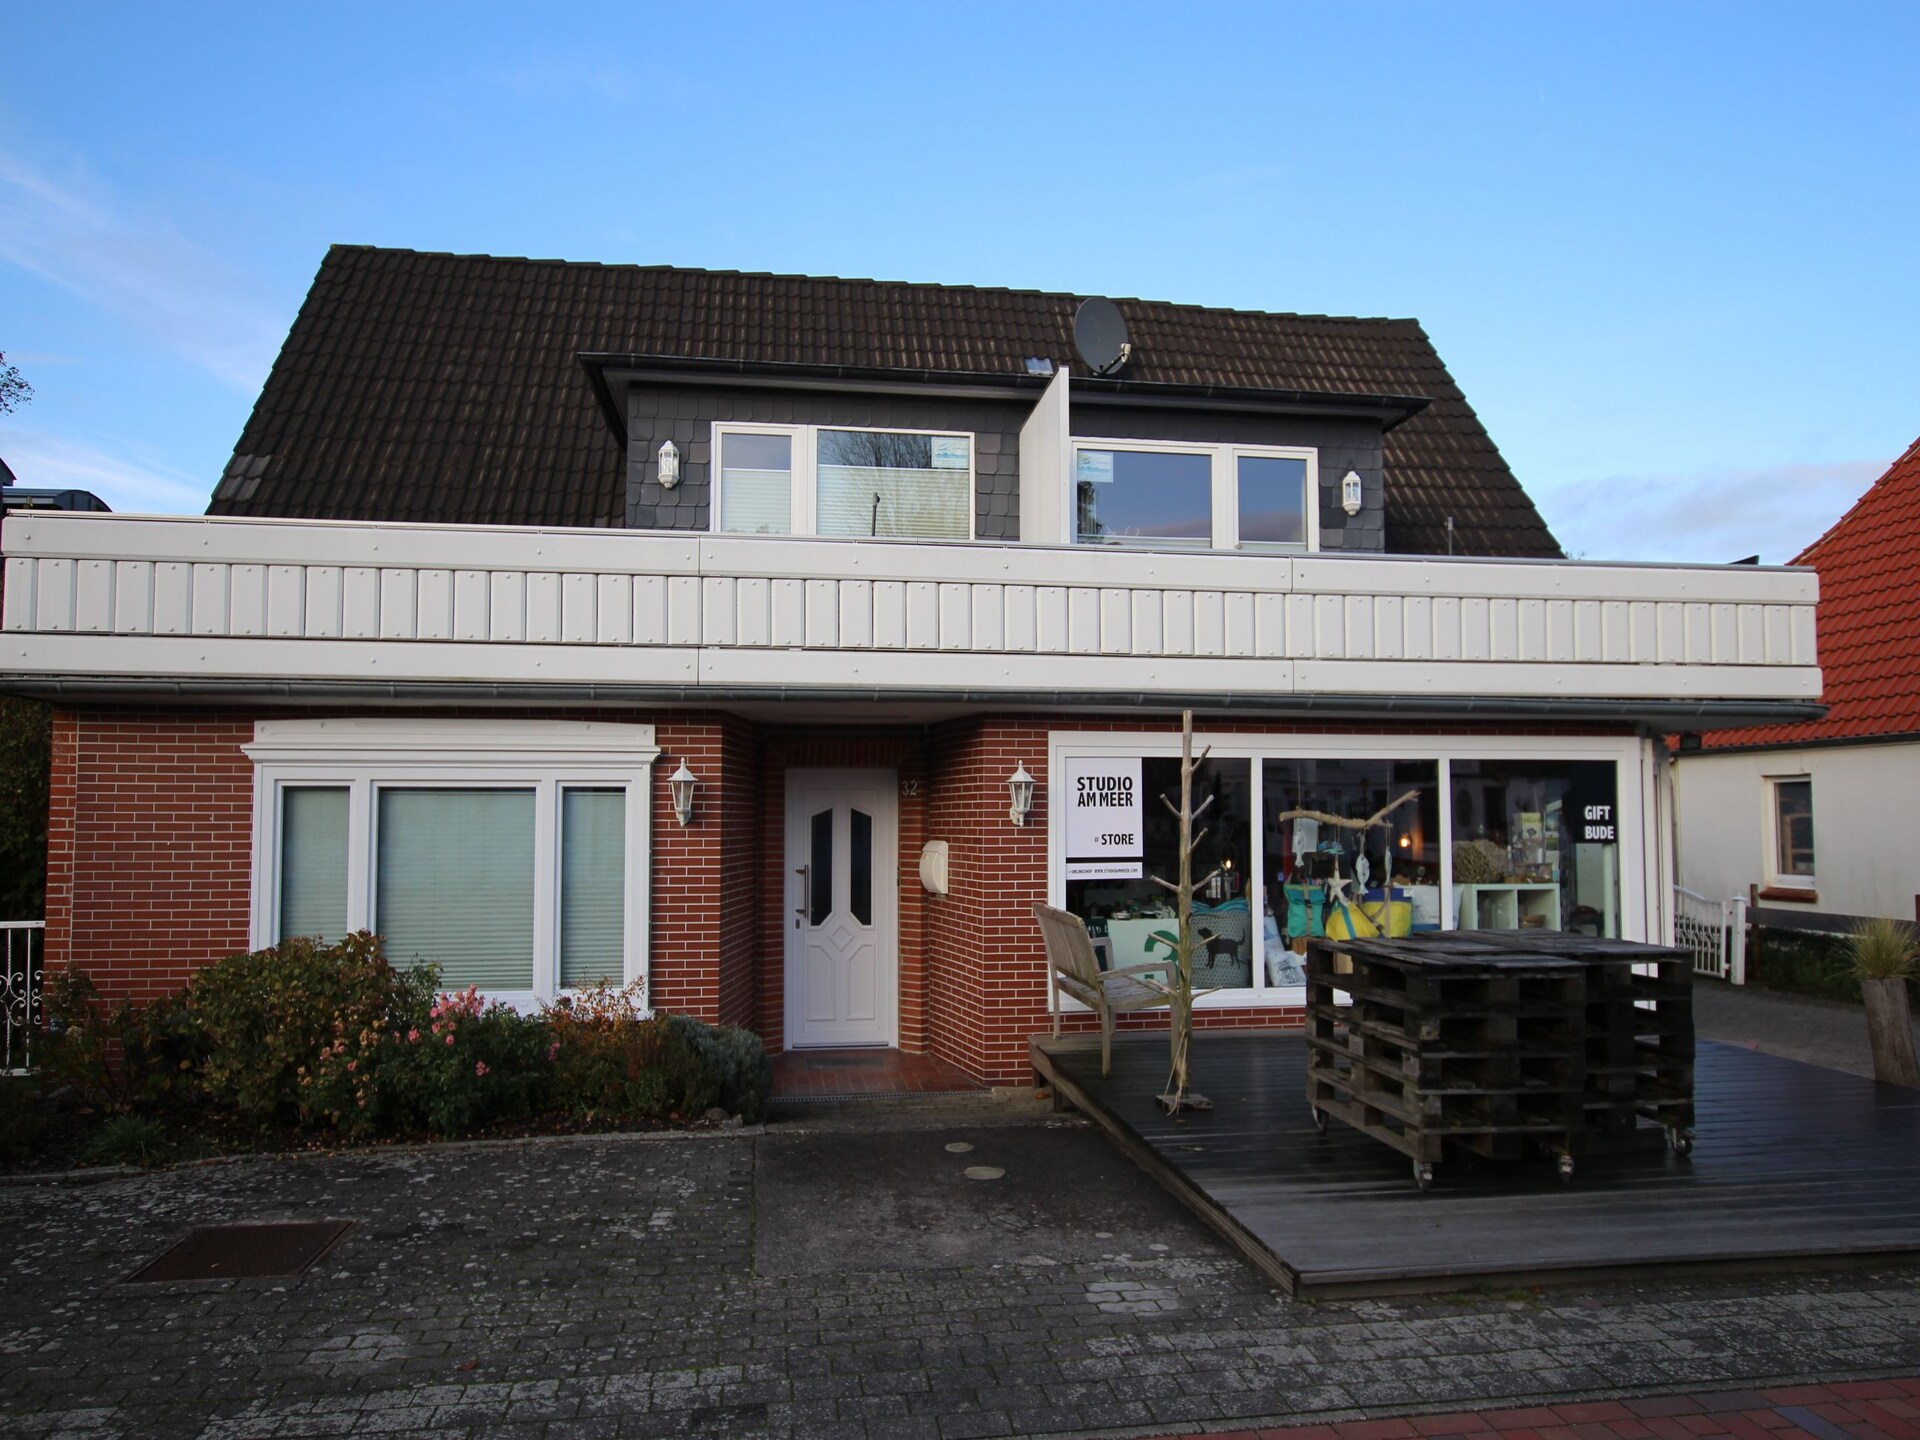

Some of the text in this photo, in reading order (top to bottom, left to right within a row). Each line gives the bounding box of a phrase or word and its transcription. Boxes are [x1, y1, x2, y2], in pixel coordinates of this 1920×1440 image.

[902, 780, 918, 796] 32
[1077, 776, 1133, 791] STUDIO
[1077, 792, 1133, 807] AM MEER
[1584, 805, 1611, 820] GIFT
[1101, 833, 1134, 845] STORE
[1584, 825, 1614, 840] BUDE
